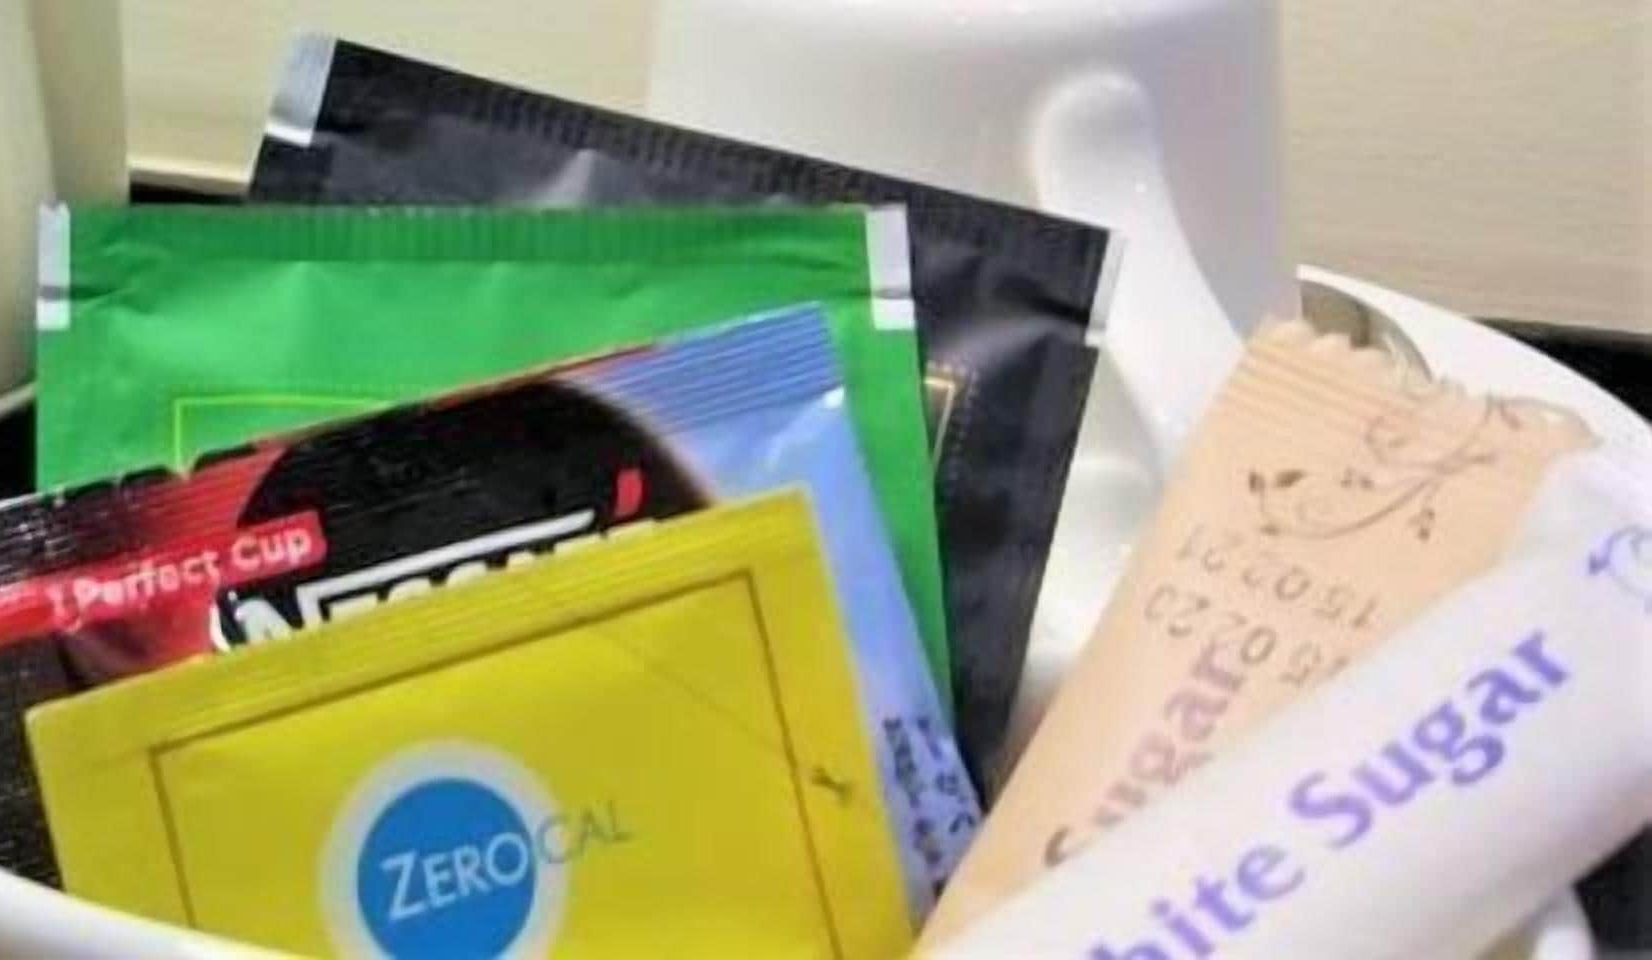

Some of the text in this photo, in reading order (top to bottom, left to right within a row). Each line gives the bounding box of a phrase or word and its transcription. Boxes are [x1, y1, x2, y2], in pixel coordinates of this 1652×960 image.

[72, 550, 221, 609] Perfect
[231, 526, 312, 572] Cup
[1090, 629, 1570, 960] ite Sugar
